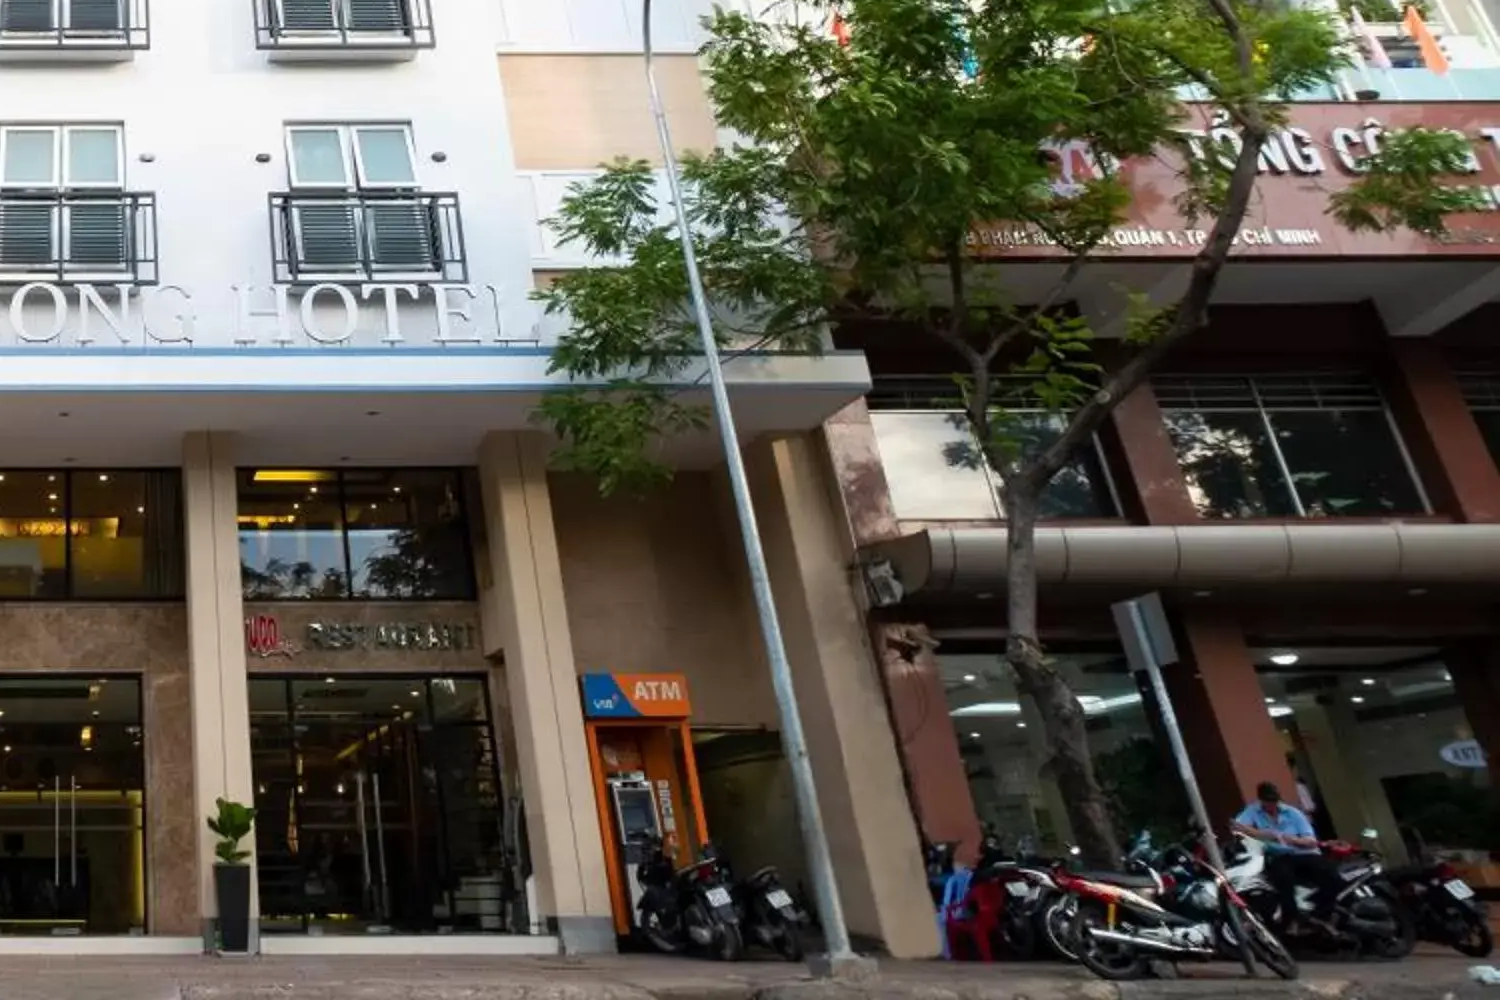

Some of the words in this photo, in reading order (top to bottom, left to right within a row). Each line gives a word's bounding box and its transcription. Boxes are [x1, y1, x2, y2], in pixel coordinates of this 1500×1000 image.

[1275, 229, 1322, 245] MINH
[232, 281, 541, 346] HOTEL
[634, 681, 683, 701] ATM
